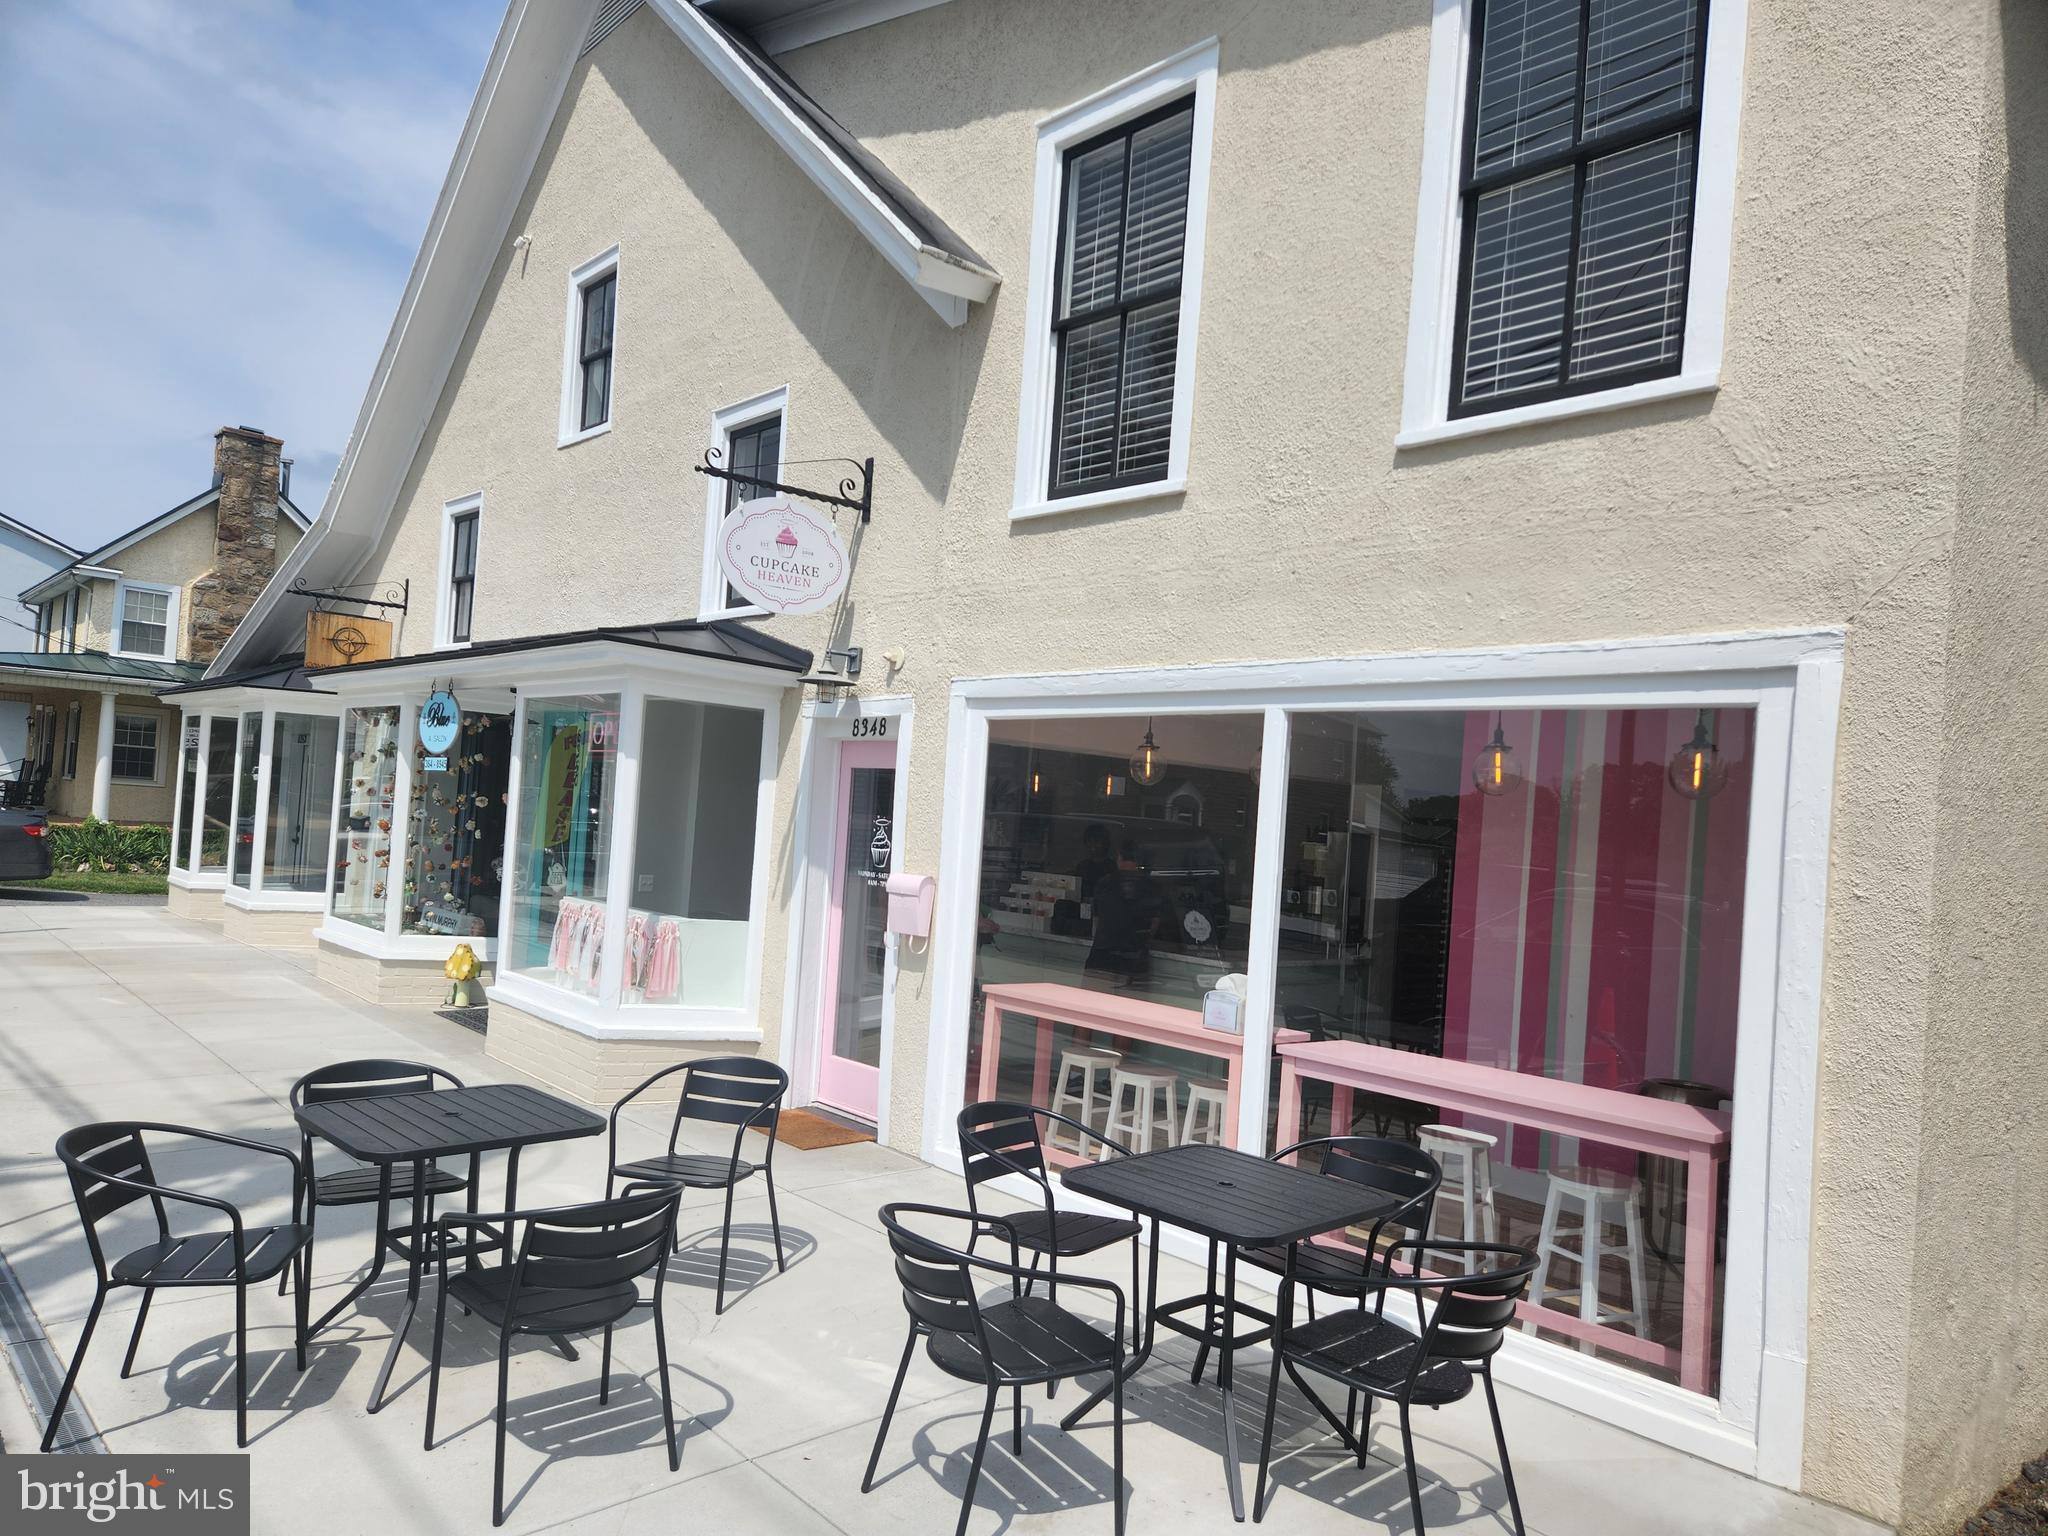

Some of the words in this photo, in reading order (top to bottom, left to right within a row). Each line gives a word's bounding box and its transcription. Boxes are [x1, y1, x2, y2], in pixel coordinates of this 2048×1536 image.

[750, 555, 820, 578] CUPCAKE
[757, 569, 812, 588] HEAVEN
[427, 702, 451, 728] Blue
[852, 717, 887, 737] 8348
